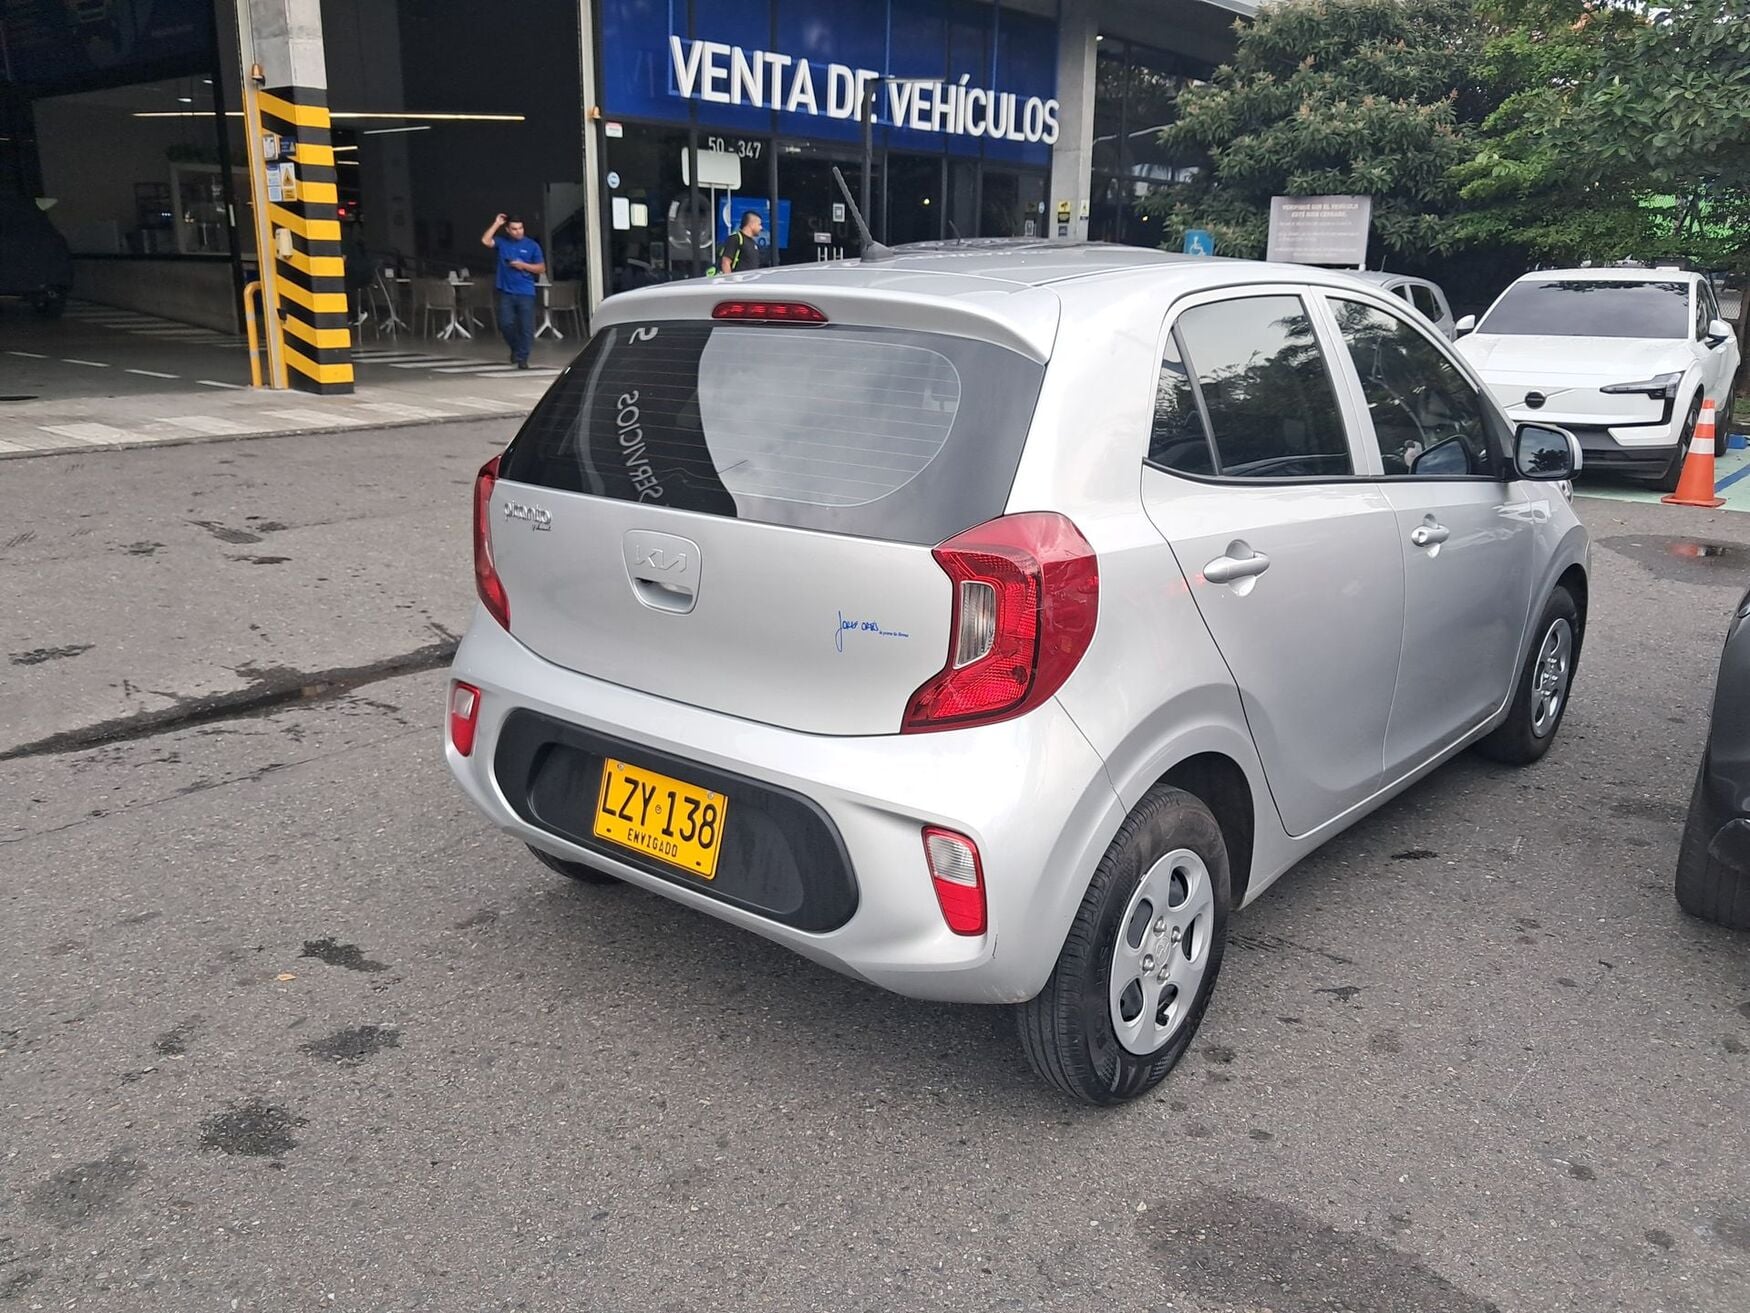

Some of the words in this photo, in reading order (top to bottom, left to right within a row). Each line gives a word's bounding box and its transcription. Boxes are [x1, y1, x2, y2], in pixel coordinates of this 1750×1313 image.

[669, 35, 819, 115] VENTA
[827, 63, 880, 124] DE
[888, 73, 1060, 145] VEHÍCULOS
[708, 136, 725, 152] 50
[737, 140, 761, 159] 347
[601, 770, 657, 827] LZY
[661, 790, 718, 850] 138
[627, 827, 678, 858] ENVIGADO
